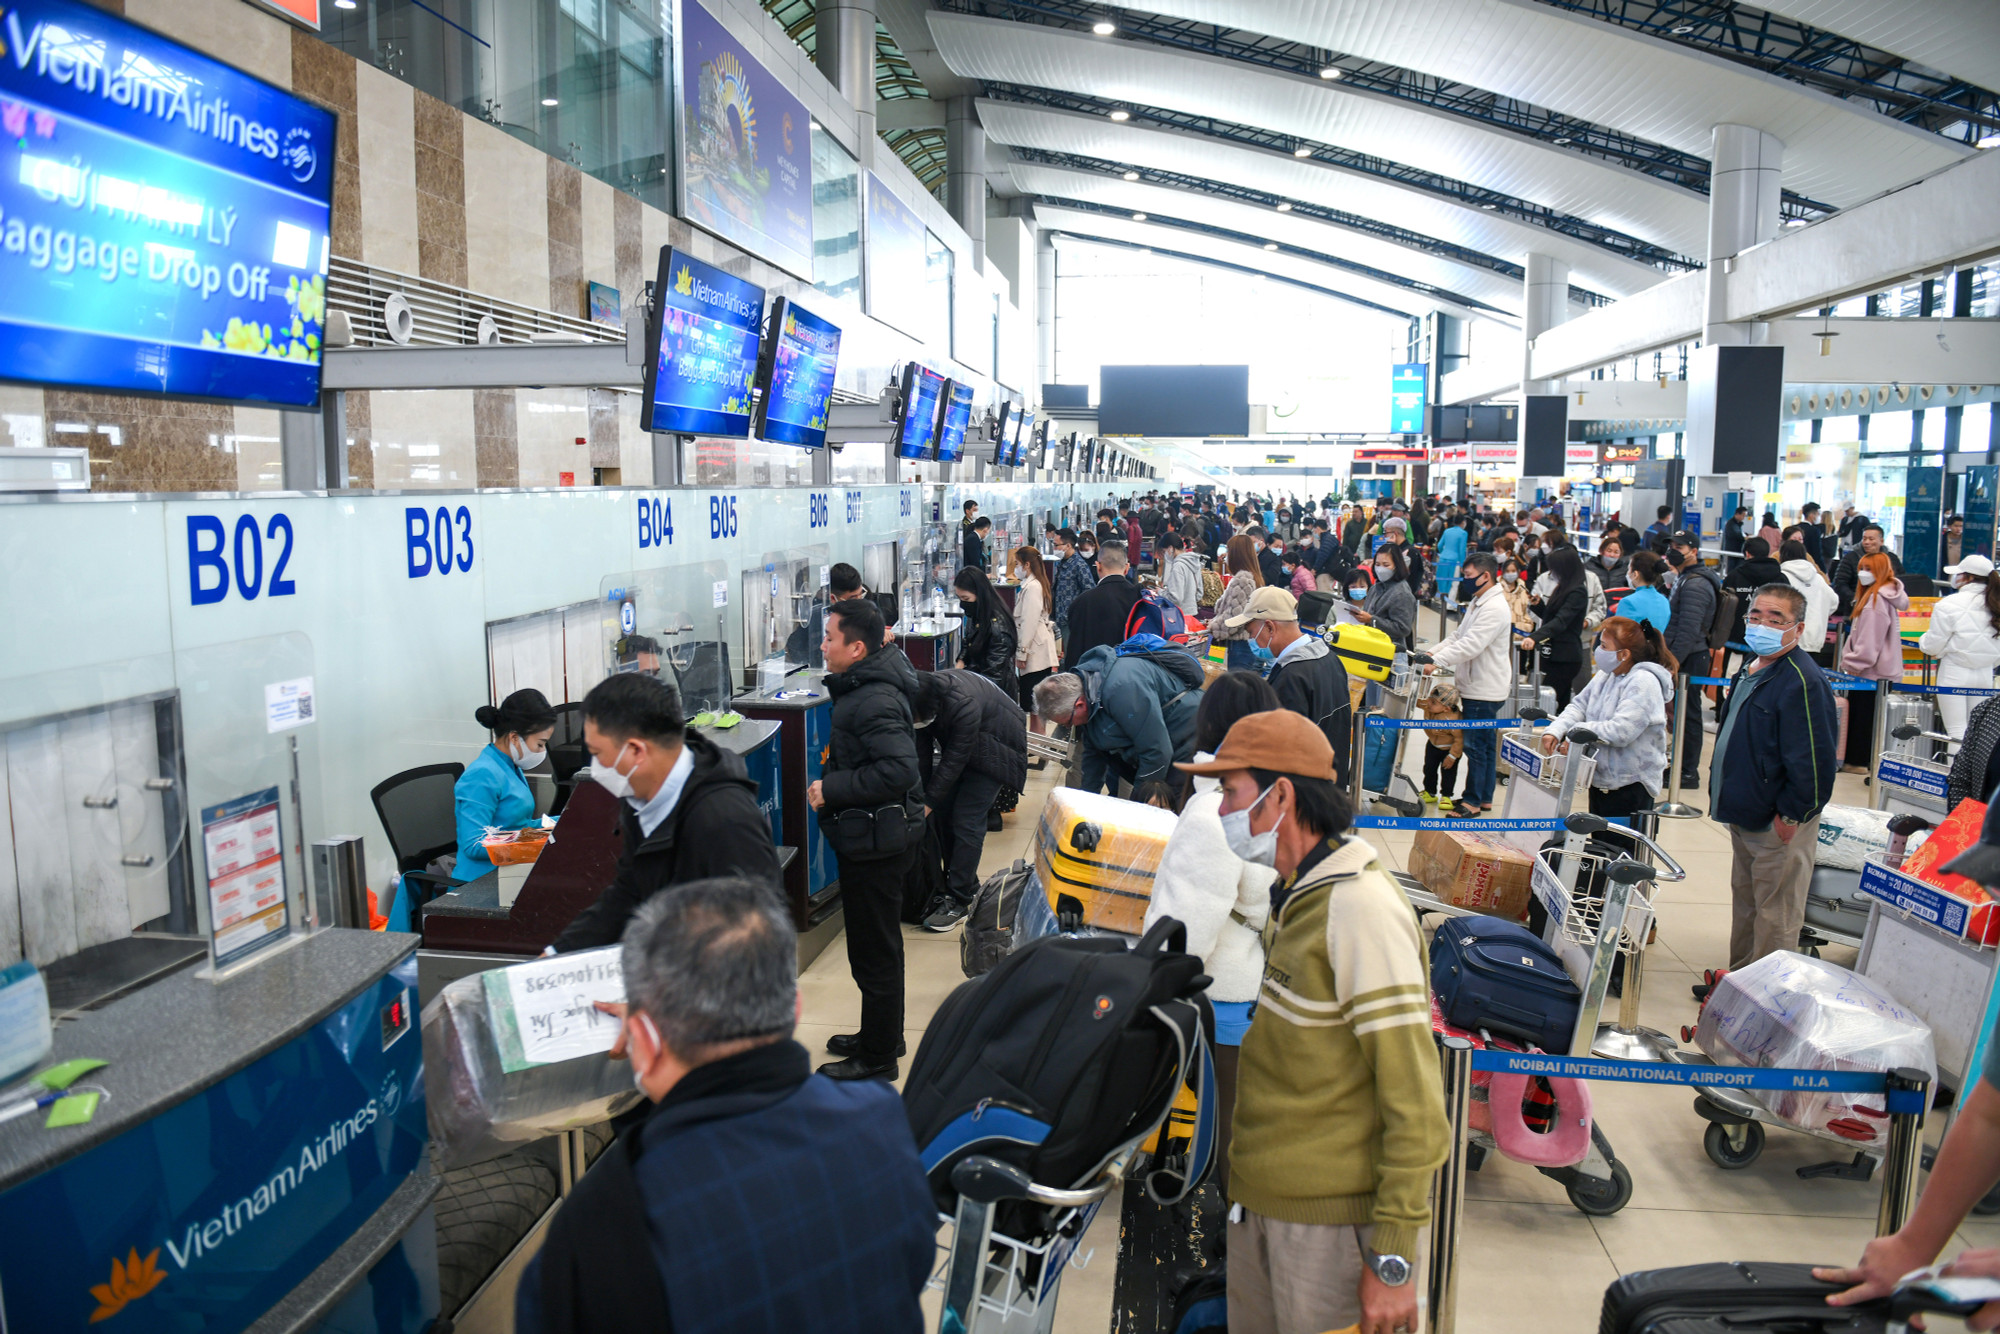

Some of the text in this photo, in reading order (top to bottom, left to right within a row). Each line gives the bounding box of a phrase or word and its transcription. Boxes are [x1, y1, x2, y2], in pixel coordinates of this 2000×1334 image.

[7, 9, 279, 159] Vietnam Airlines
[207, 204, 239, 246] LÝ
[0, 208, 271, 302] aggage Drop Off
[692, 278, 750, 318] Vietnam Airlines
[678, 359, 711, 385] Baggage
[1476, 449, 1505, 457] LUCKY
[637, 497, 673, 548] B04
[709, 495, 738, 539] B05
[810, 493, 828, 528] B06
[847, 491, 861, 523] B07
[186, 513, 296, 606] B02
[405, 505, 474, 578] B03
[607, 587, 626, 601] ACV
[1377, 819, 1557, 829] N.I.A NOIBAI INTERNATIONAL AIRPORT
[1893, 878, 1914, 896] 20.000
[1926, 876, 1946, 888] HAPPY
[1509, 1058, 1829, 1088] NOIBAI INTERNATIONAL AIRPORT N.I.A
[165, 1099, 378, 1269] Vietnam Airlines
